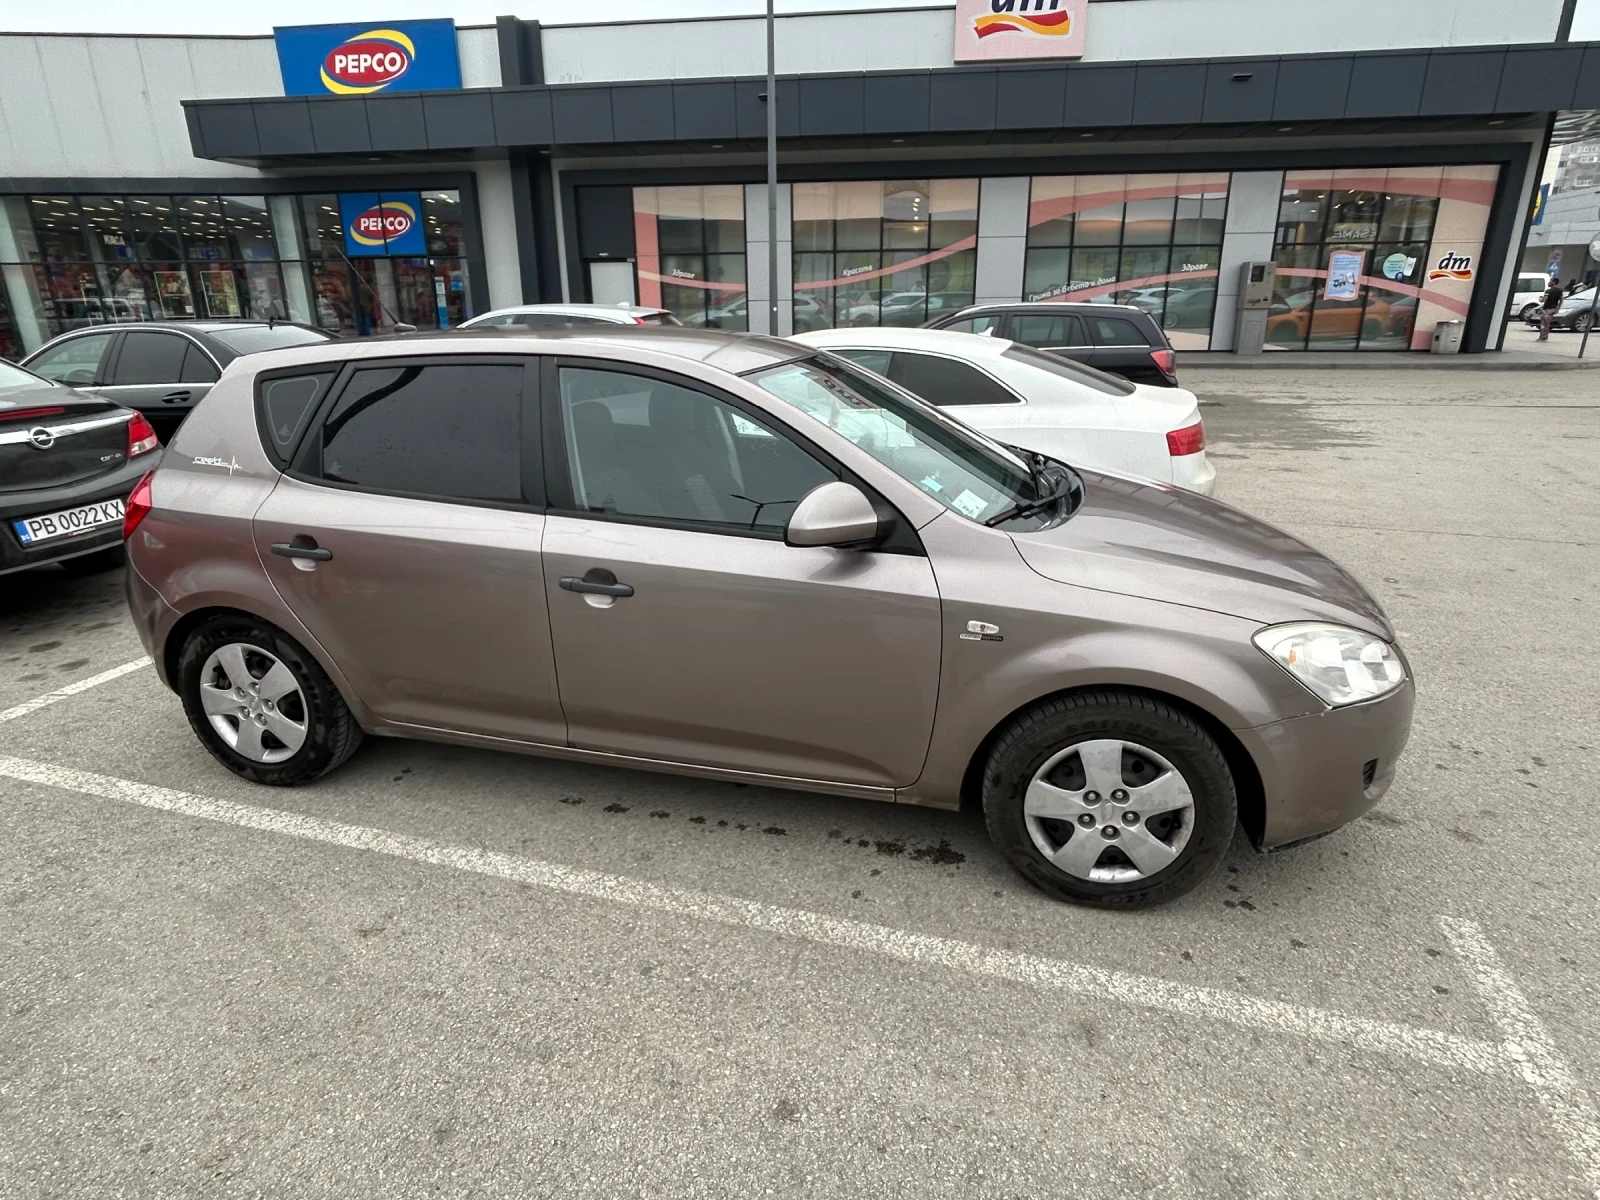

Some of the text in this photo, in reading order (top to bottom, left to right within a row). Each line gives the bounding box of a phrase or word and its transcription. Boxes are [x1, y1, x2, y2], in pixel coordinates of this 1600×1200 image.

[334, 52, 402, 74] PEPCO
[360, 217, 407, 231] PEPCO
[1181, 263, 1208, 272] Здраве
[1438, 251, 1471, 270] dm
[842, 264, 873, 277] Красота
[1028, 290, 1051, 302] Грижа
[1097, 276, 1116, 285] дома
[28, 517, 57, 538] PB
[58, 507, 102, 530] 0022
[100, 501, 125, 521] KX
